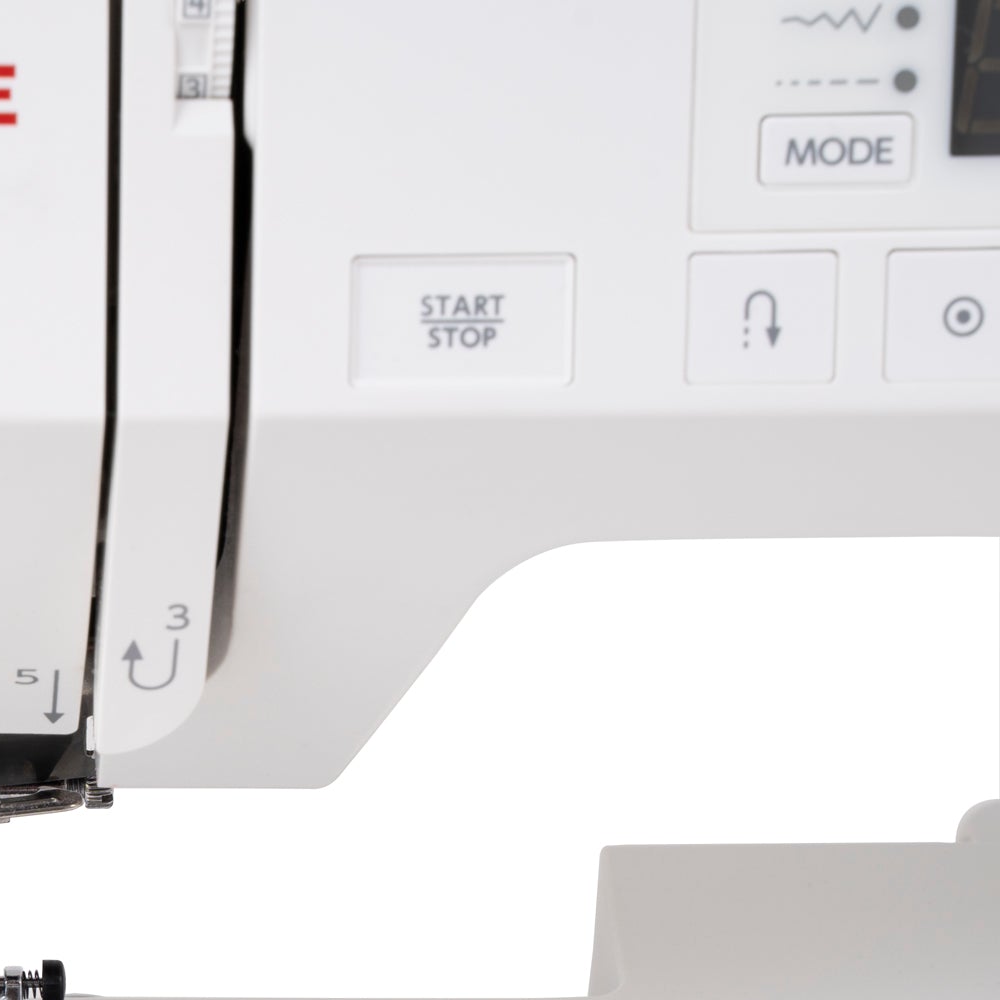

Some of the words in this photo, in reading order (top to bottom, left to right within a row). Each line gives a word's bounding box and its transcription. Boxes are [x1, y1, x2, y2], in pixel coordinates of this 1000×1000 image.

[785, 136, 894, 166] MODE
[420, 294, 505, 317] START
[428, 326, 497, 349] STOP
[165, 603, 191, 631] 3
[14, 668, 39, 686] 5
